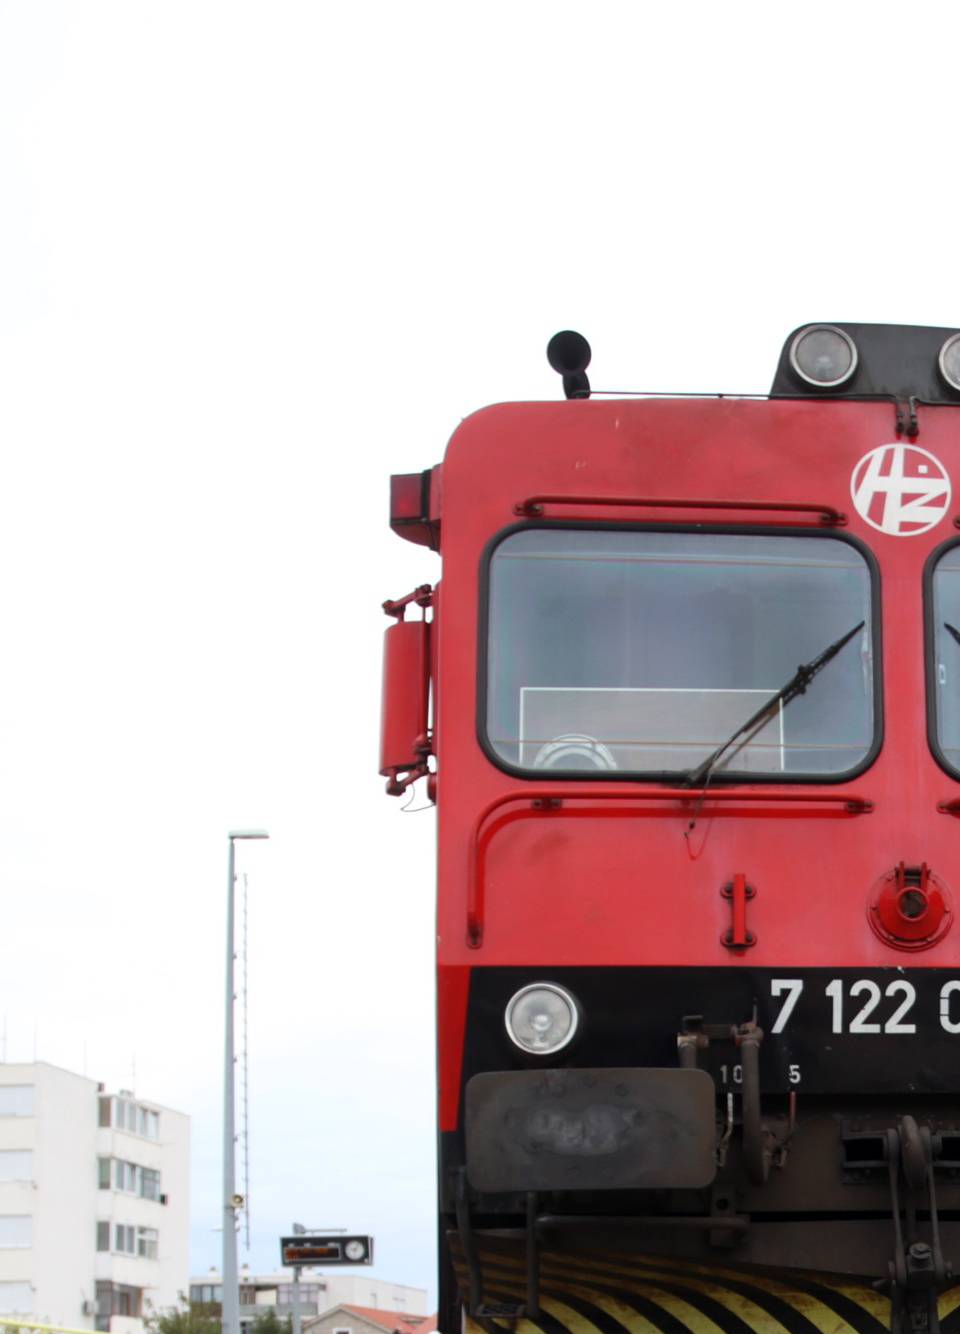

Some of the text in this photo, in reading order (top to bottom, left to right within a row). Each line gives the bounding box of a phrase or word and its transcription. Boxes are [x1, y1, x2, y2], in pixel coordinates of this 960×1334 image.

[770, 979, 803, 1034] 7
[825, 979, 917, 1034] 122
[720, 1065, 742, 1084] 10
[789, 1064, 801, 1084] 5
